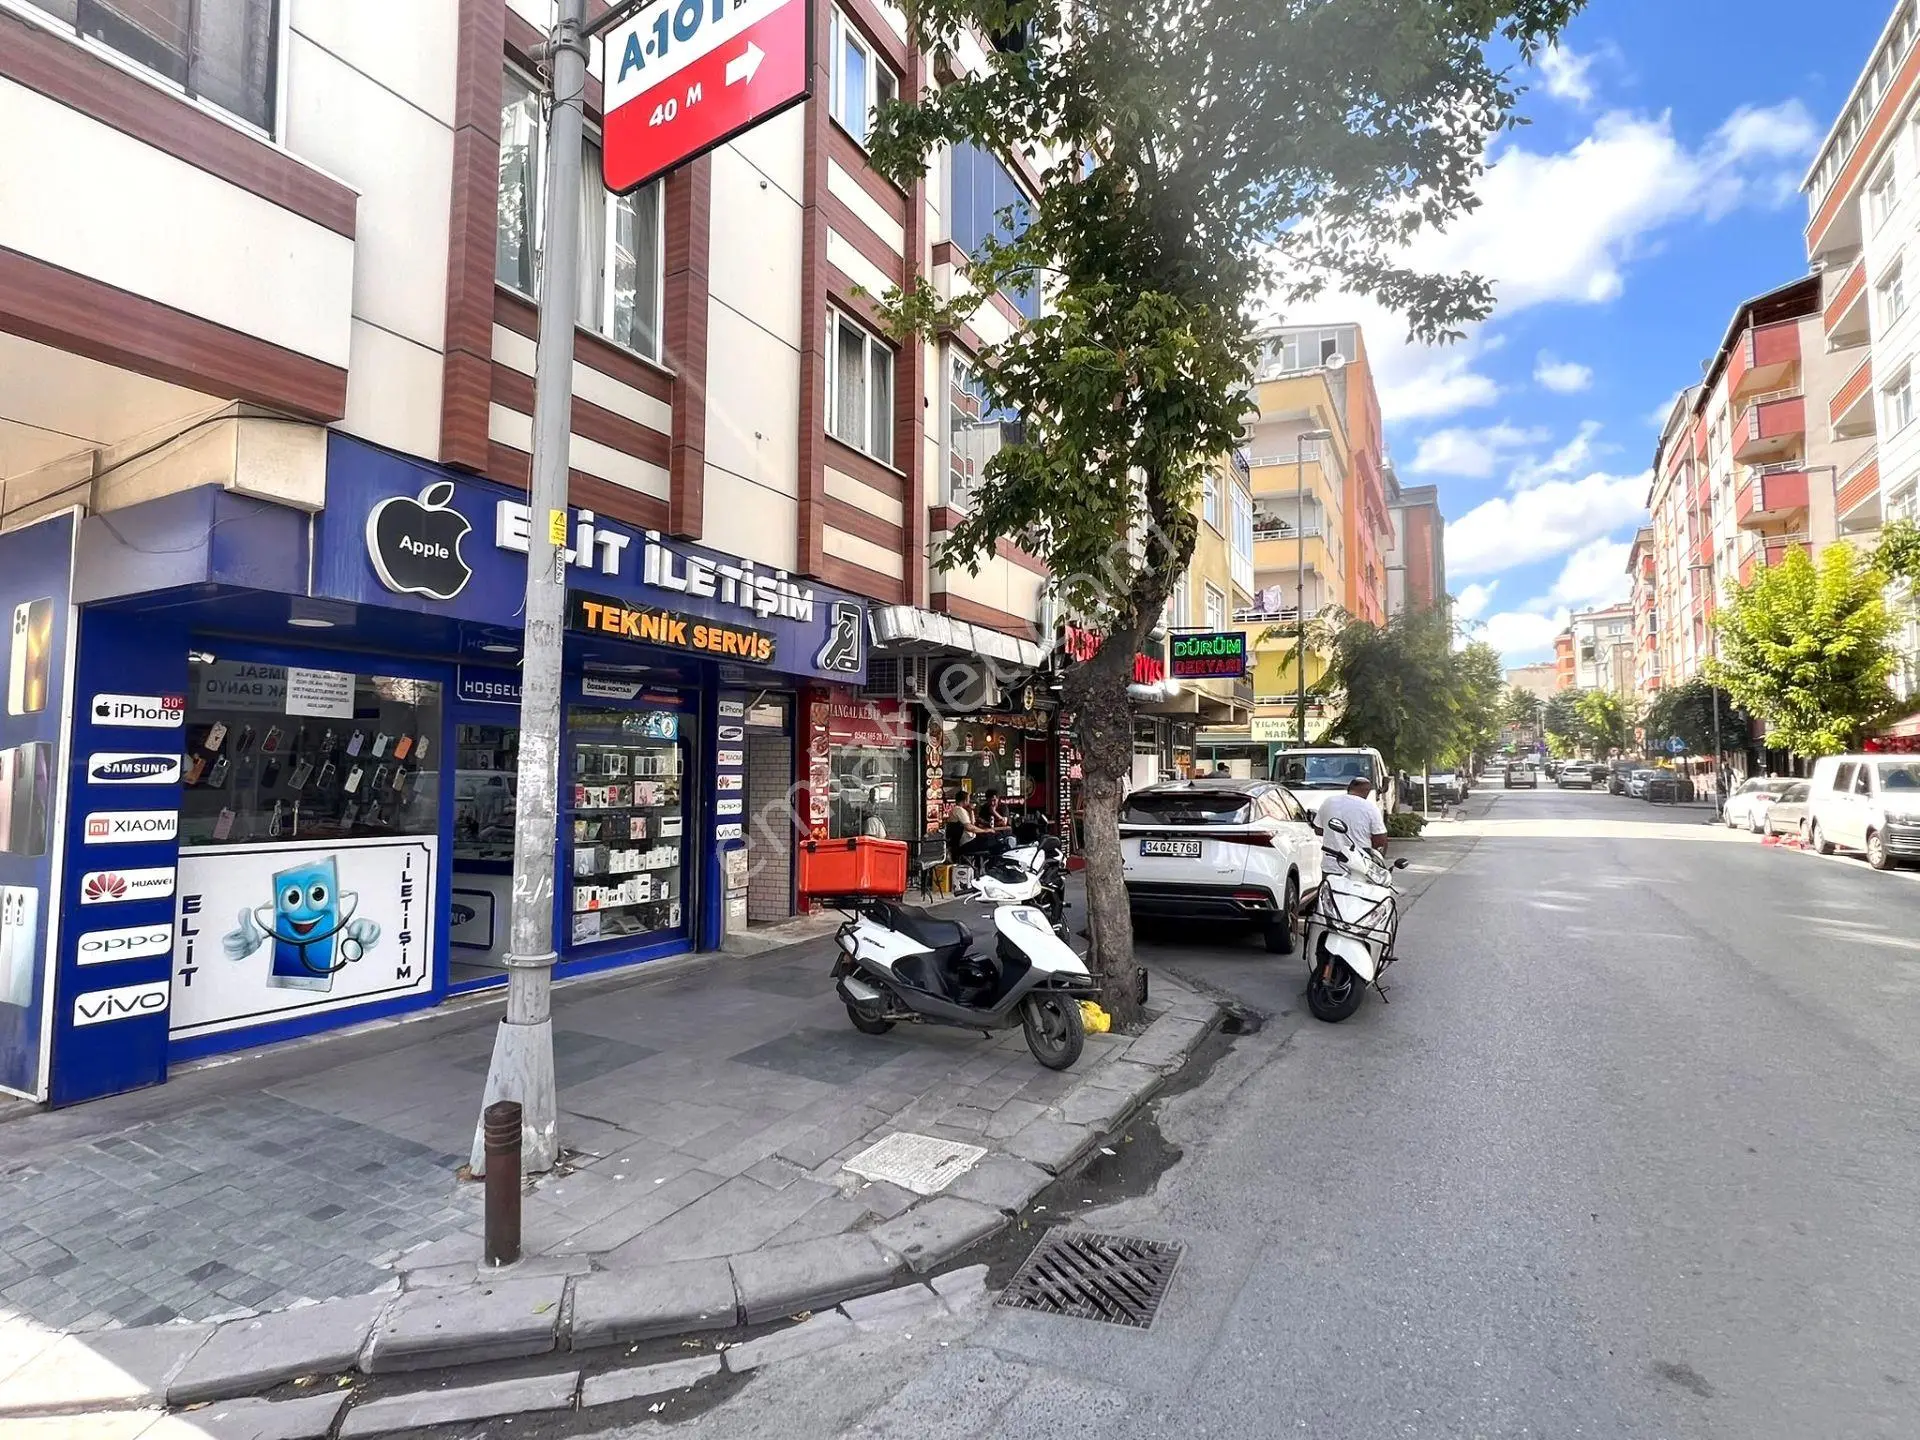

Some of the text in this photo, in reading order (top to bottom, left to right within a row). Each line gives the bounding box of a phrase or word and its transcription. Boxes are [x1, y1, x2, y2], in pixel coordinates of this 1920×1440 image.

[649, 82, 702, 127] 40 M
[399, 535, 449, 559] Apple
[496, 500, 813, 623] EİT İLETİŞİM
[583, 602, 771, 660] TEKNİK SERVİS
[1174, 637, 1242, 656] DÜRÜM
[1175, 659, 1241, 674] DERYASI
[114, 703, 181, 720] iPhone
[1254, 720, 1292, 728] YILMA
[103, 763, 169, 774] SAMSUNG
[114, 819, 175, 832] XIAOMI
[1147, 842, 1158, 852] 34
[1160, 842, 1177, 853] GZE
[1180, 843, 1198, 853] 768
[131, 878, 172, 888] HUAWEI
[397, 852, 413, 980] İLETİŞİM
[82, 933, 169, 952] oppo
[178, 894, 202, 987] ELİT
[78, 992, 165, 1018] vivo
